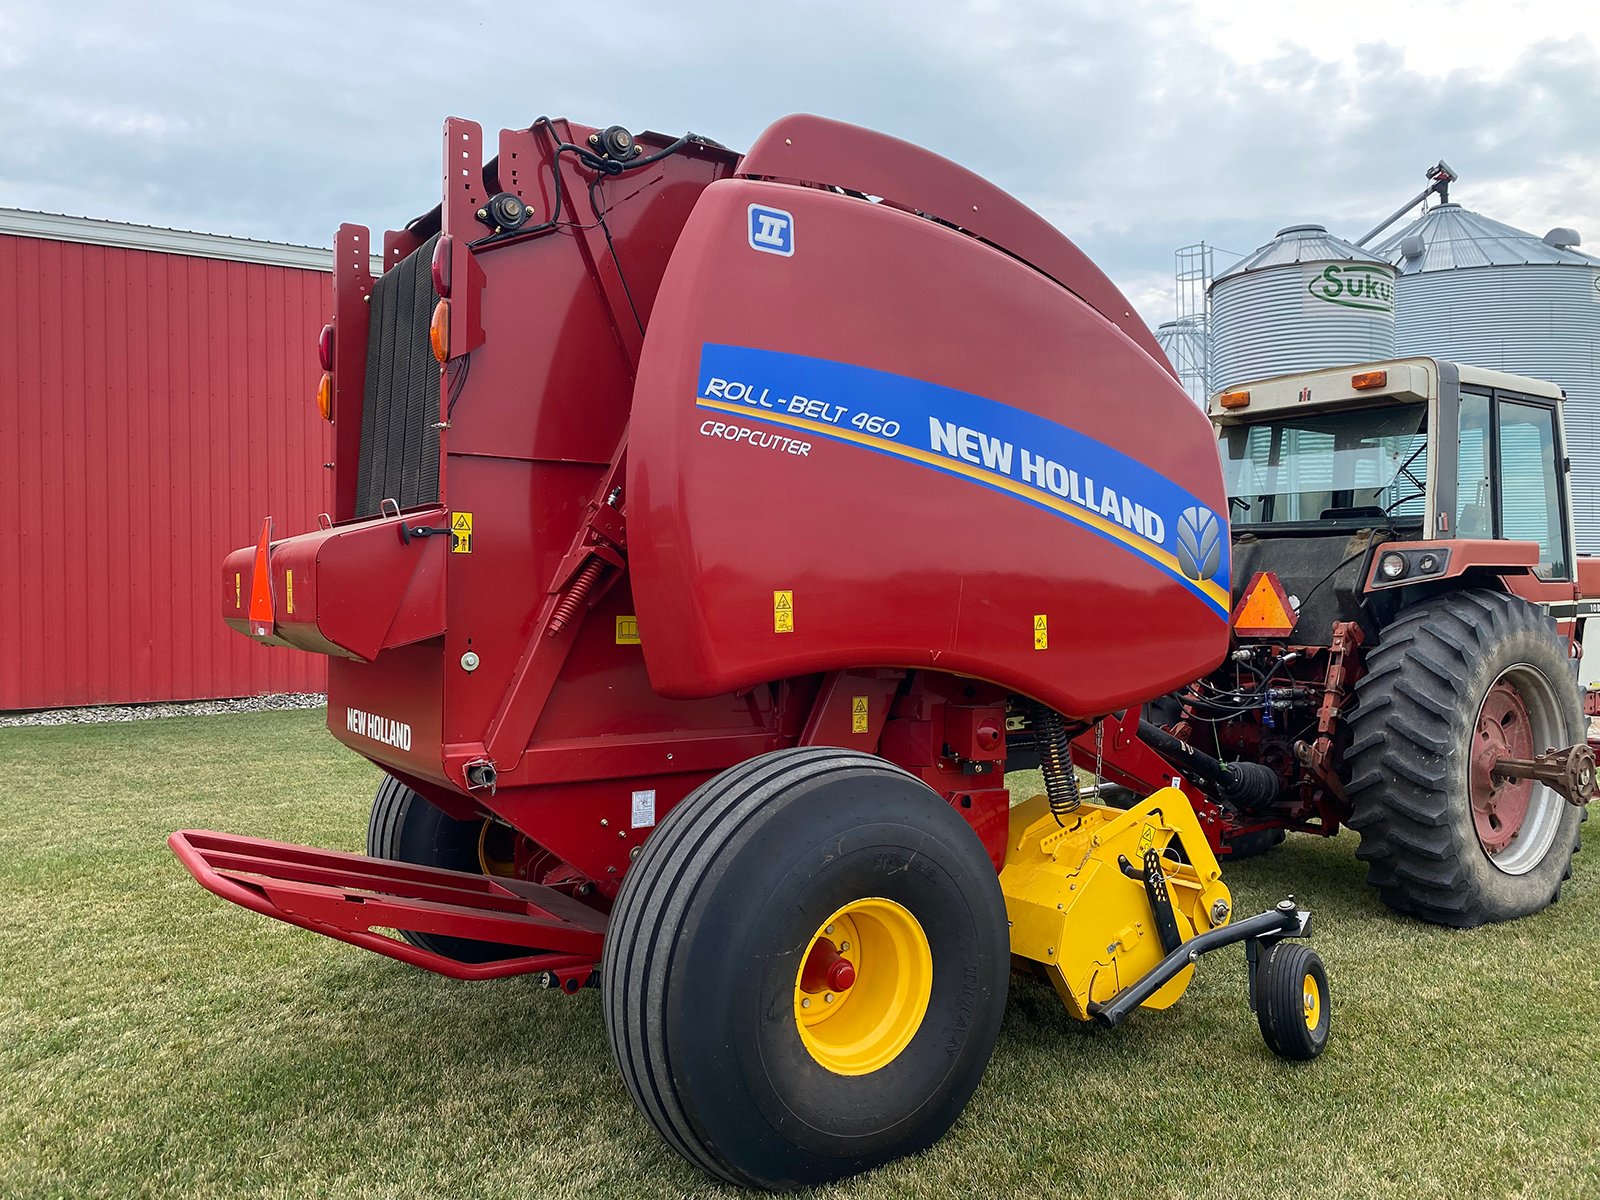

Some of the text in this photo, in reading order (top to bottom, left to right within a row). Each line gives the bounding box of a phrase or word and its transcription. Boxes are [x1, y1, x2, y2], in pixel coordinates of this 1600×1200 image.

[704, 377, 901, 439] ROLL-BELT 460
[699, 420, 812, 457] CROPCUTTER
[928, 416, 1165, 545] NEW HOLLAND
[347, 706, 412, 752] NEW HOLLAND
